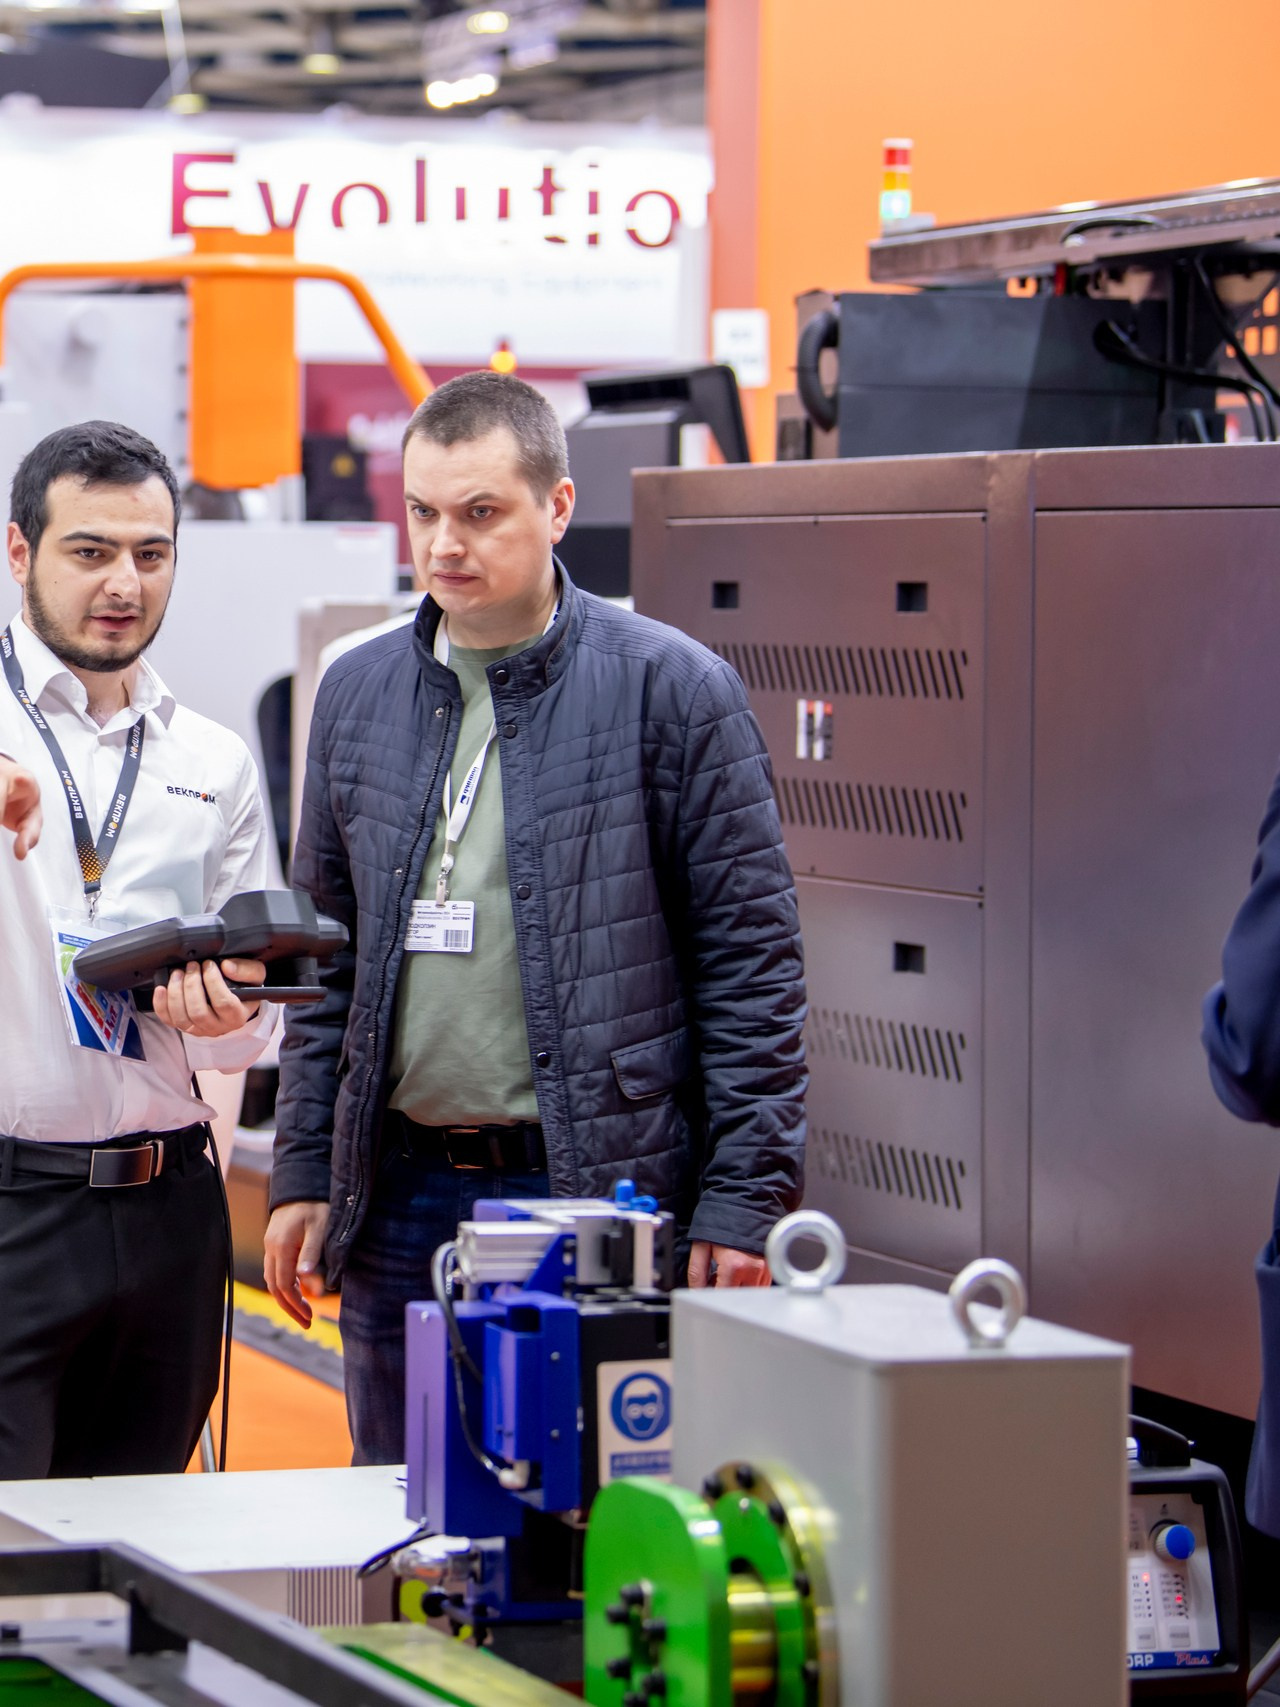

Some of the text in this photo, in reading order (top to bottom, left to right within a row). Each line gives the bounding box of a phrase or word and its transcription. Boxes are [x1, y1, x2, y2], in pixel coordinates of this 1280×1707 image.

[61, 770, 84, 819] ВЕКПРОМ
[105, 793, 127, 838] ВЕКПРОМ
[166, 785, 217, 805] ВЕКПРОМ
